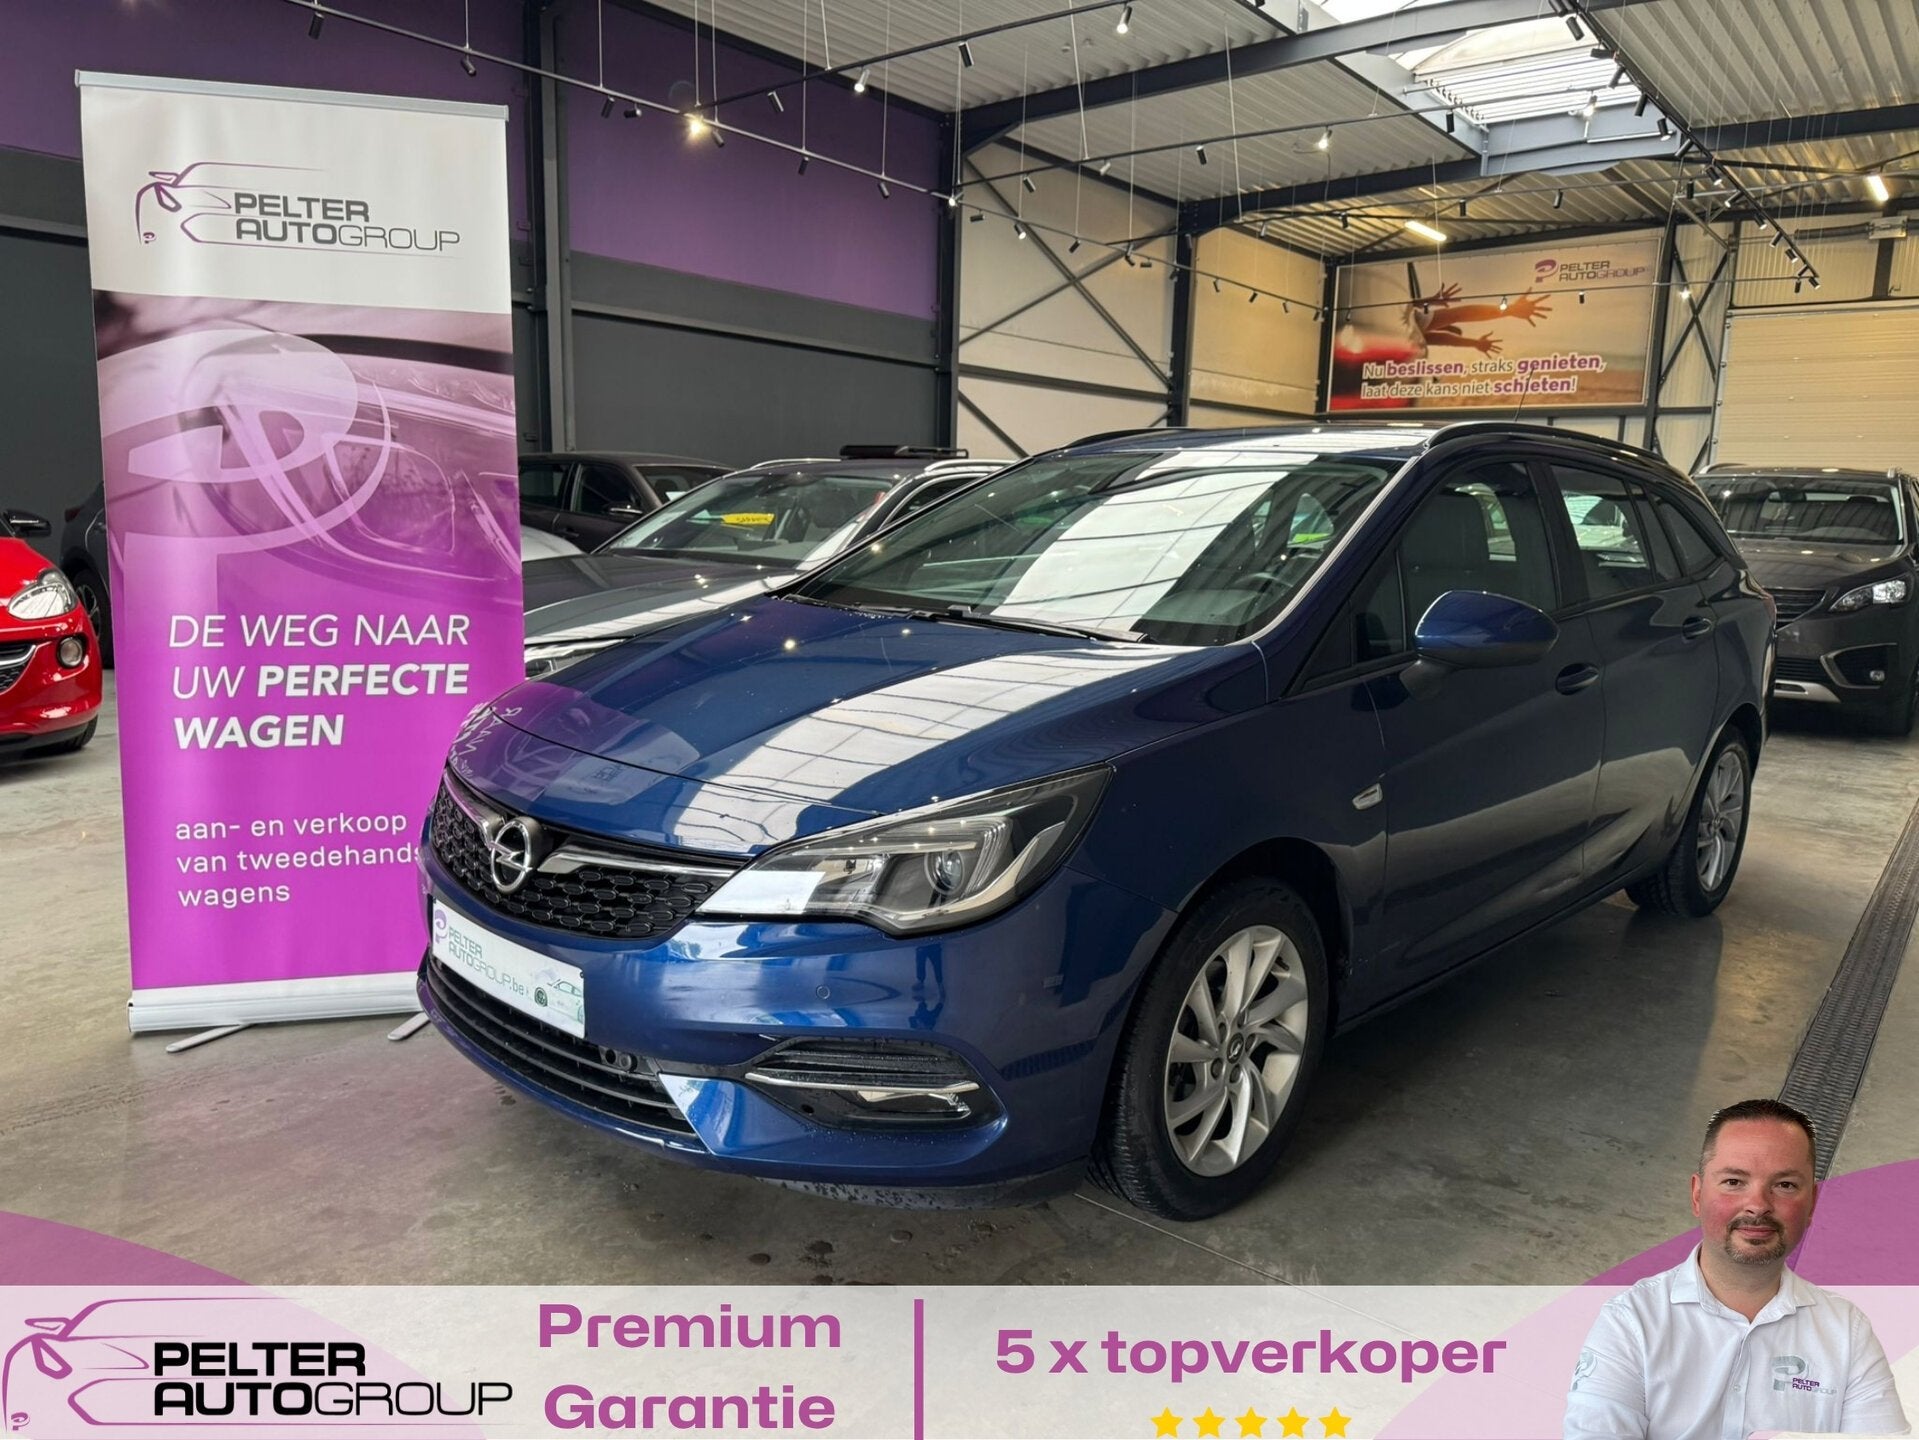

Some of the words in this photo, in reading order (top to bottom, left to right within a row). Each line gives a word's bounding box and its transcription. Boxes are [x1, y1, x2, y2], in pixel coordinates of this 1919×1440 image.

[234, 192, 369, 223] PELTER
[236, 217, 460, 251] AUTOGROUP
[1559, 260, 1610, 272] PELTER
[1559, 266, 1646, 282] AUTOGROUP
[1363, 363, 1384, 378] Nu
[1386, 360, 1467, 376] beslissen,
[1471, 358, 1513, 373] straks
[1517, 354, 1605, 374] genieten,
[1362, 383, 1387, 397] laat
[1389, 382, 1423, 395] deze
[1425, 381, 1459, 395] kans
[1461, 379, 1490, 394] niet
[168, 614, 227, 649] DE
[239, 613, 340, 648] WEG
[354, 614, 471, 647] NAAR
[172, 665, 247, 700] UW
[257, 663, 470, 698] PERFECTE
[173, 714, 345, 750] WAGEN
[175, 822, 241, 841] aan-
[250, 819, 285, 838] en
[293, 812, 407, 836] verkoop
[176, 855, 228, 875] van
[177, 885, 291, 910] wagens
[448, 926, 483, 959] PELTER
[1792, 1377, 1820, 1387] PELTER
